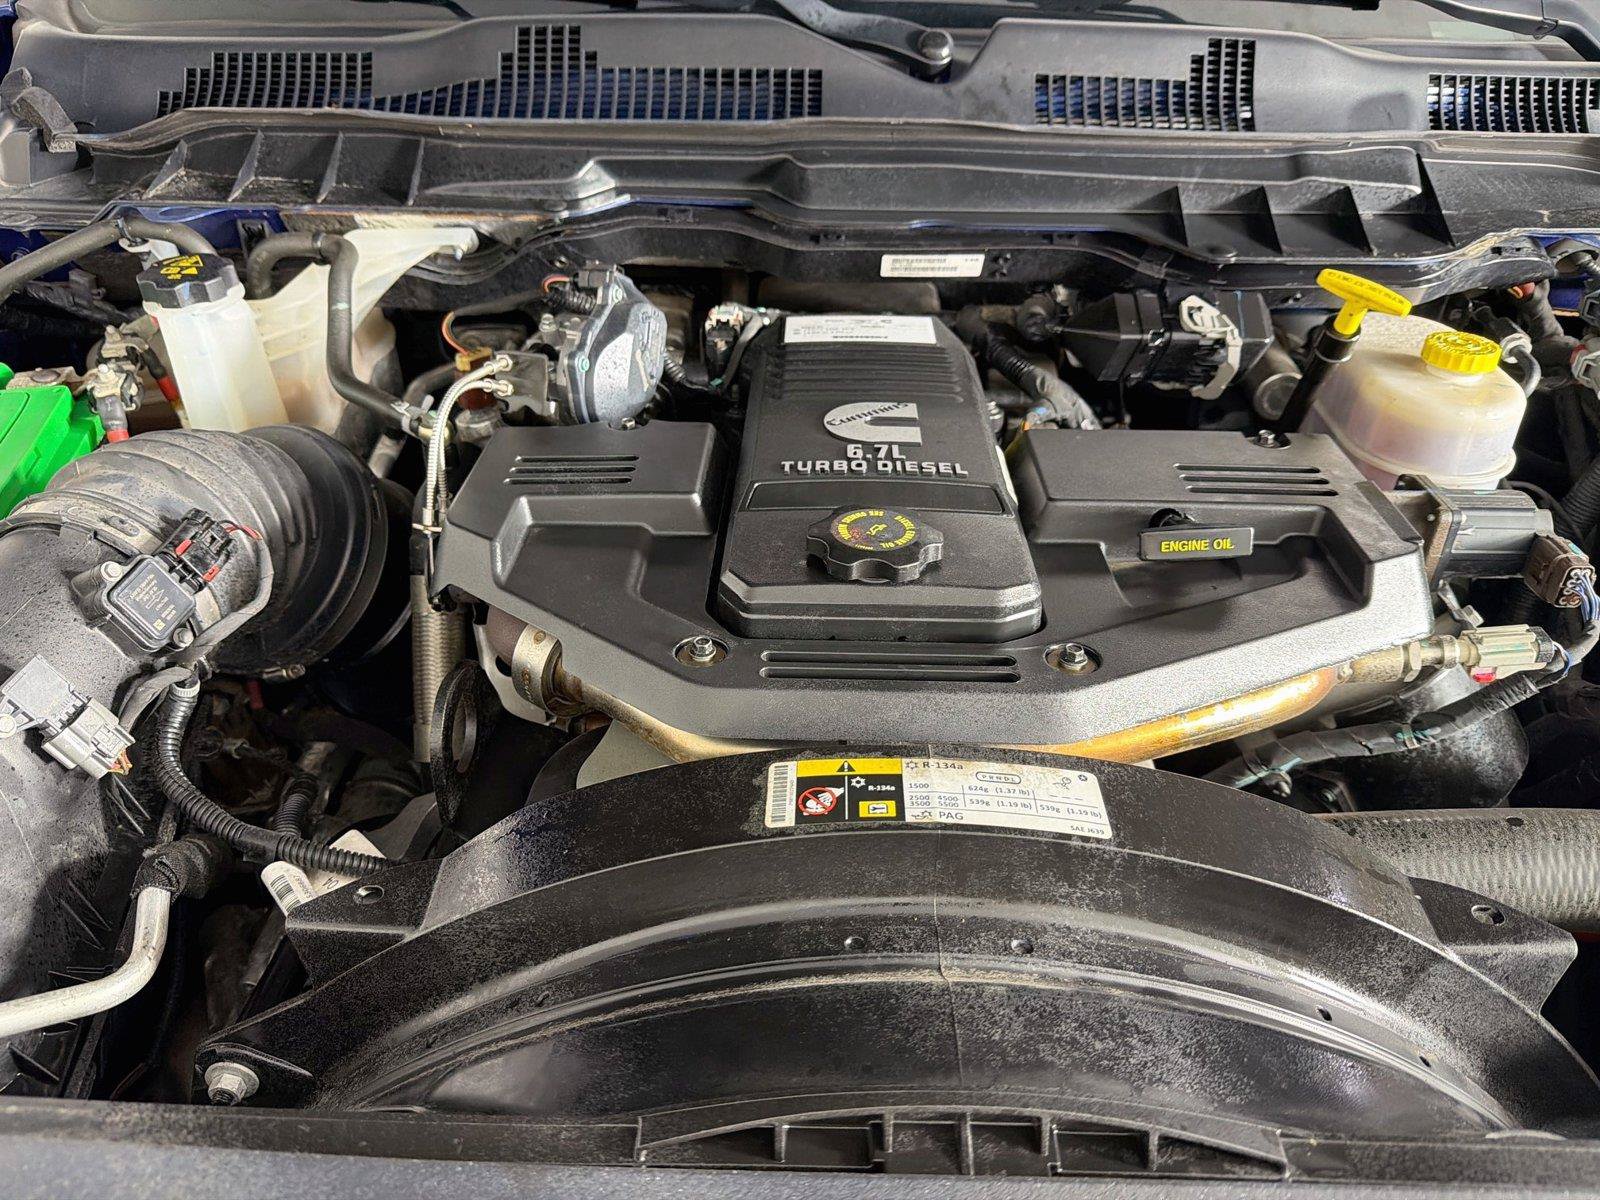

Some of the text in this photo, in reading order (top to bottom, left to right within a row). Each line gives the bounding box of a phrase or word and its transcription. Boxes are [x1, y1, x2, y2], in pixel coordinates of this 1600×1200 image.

[827, 402, 909, 425] Cummins
[846, 443, 907, 460] 6.7L
[780, 459, 969, 478] TURBO DIESEL
[1160, 537, 1236, 553] ENGINE OIL
[922, 761, 964, 770] R-134a
[967, 785, 1030, 797] 624g (1.37 lb)
[969, 798, 1033, 810] 539g (1.19 lb)
[938, 811, 964, 820] PAG
[1039, 803, 1103, 820] 539g (1.19 lb)
[1070, 825, 1086, 833] SAE
